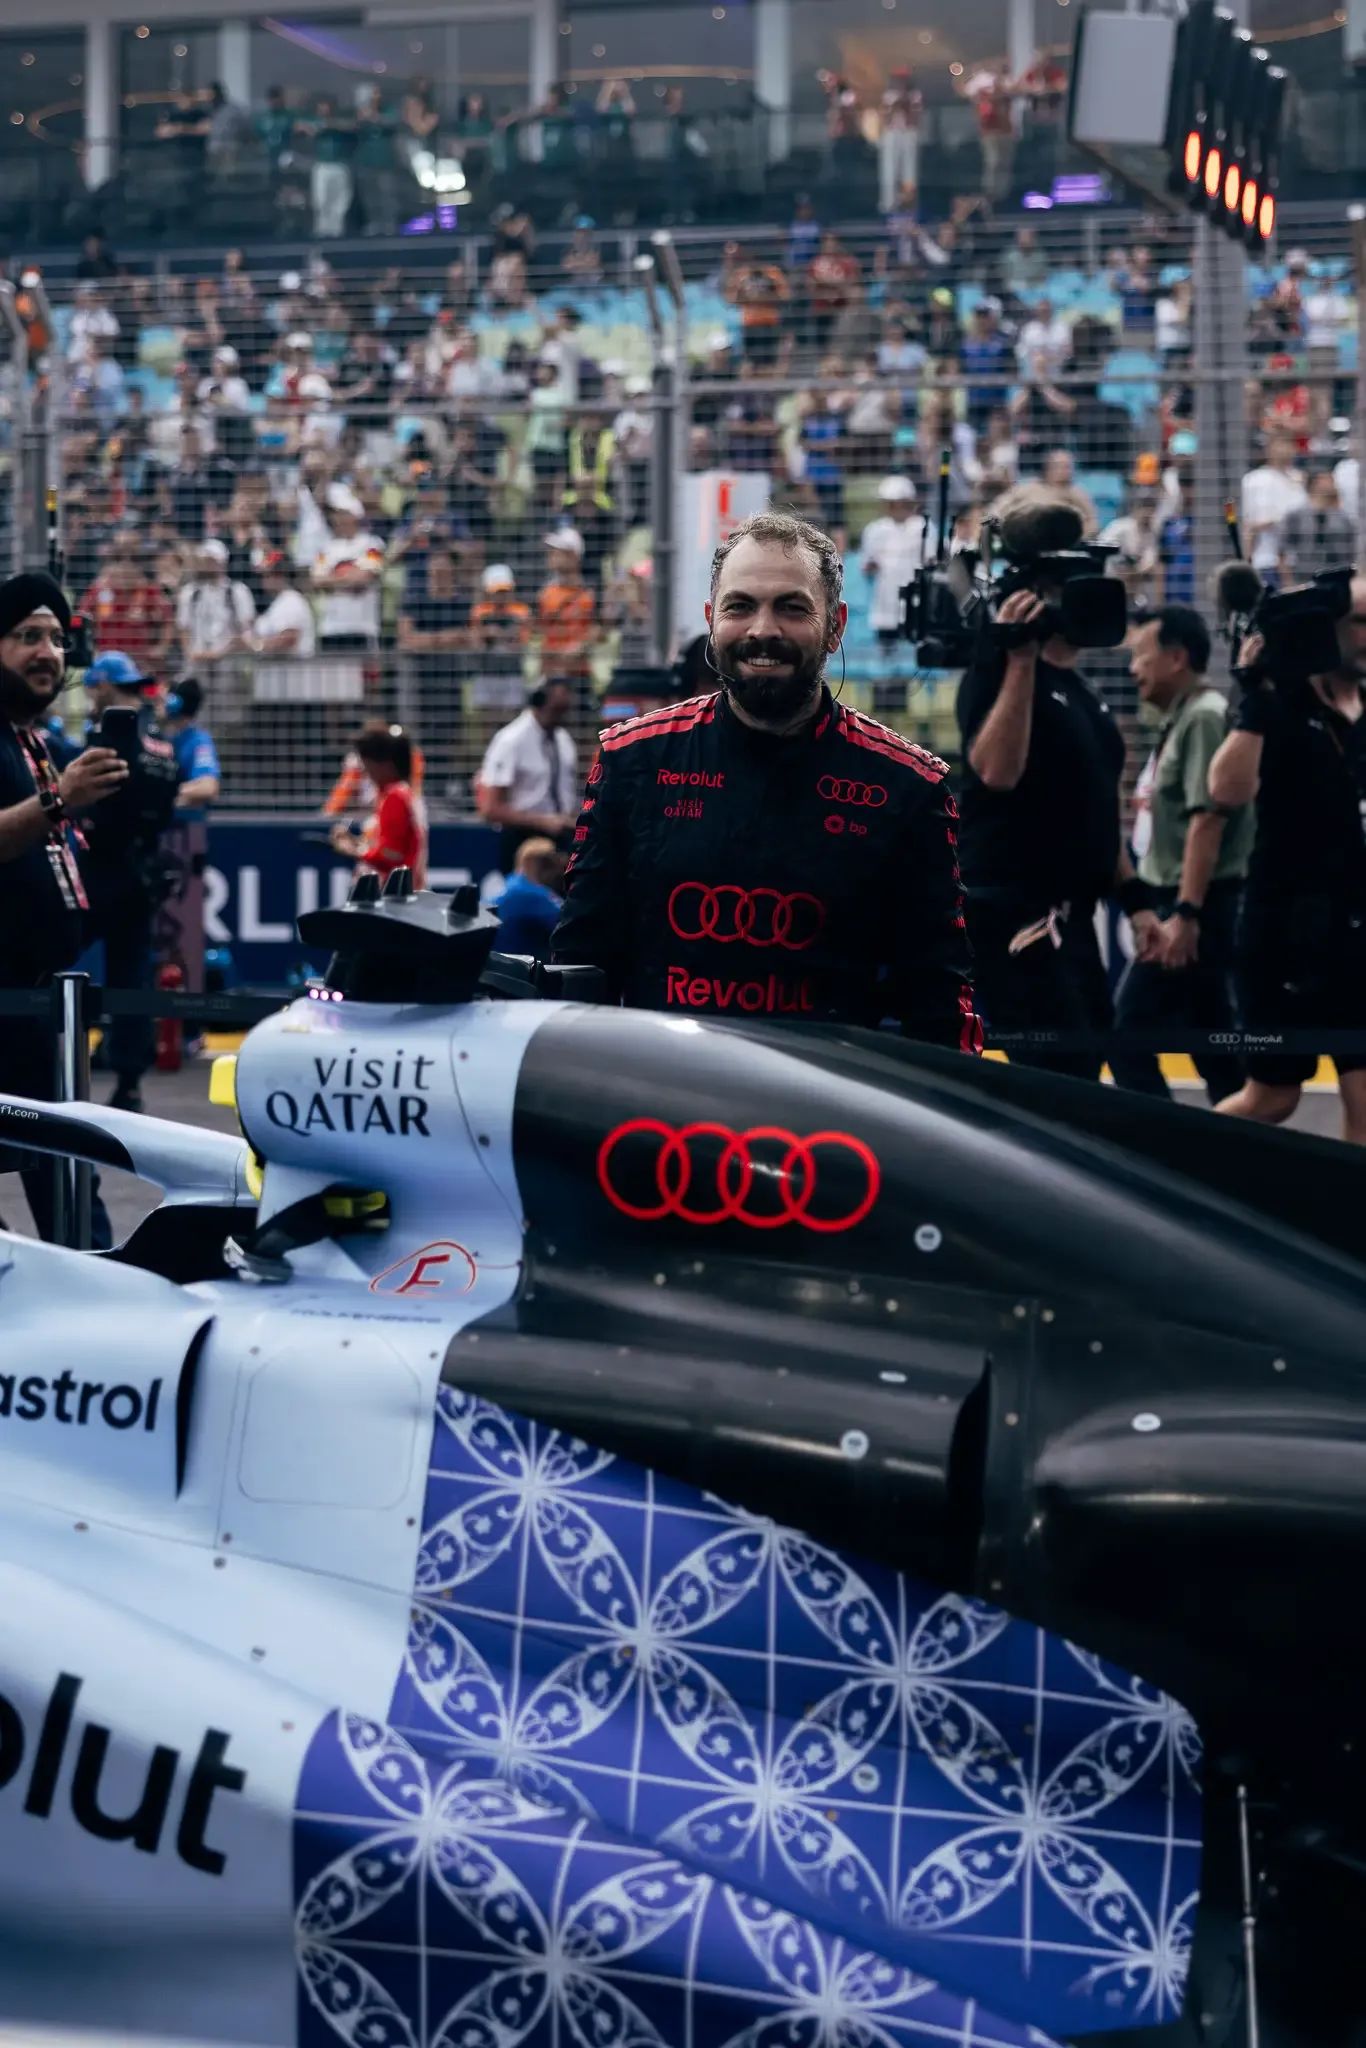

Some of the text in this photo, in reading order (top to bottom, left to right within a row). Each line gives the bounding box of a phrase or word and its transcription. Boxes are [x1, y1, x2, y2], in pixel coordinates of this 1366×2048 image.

[656, 769, 724, 788] Revolut
[664, 806, 702, 818] QATAR
[849, 821, 867, 835] bp
[667, 966, 813, 1012] Revolut
[1244, 1033, 1283, 1044] Revolut
[314, 1047, 435, 1090] visit
[266, 1090, 432, 1137] QATAR
